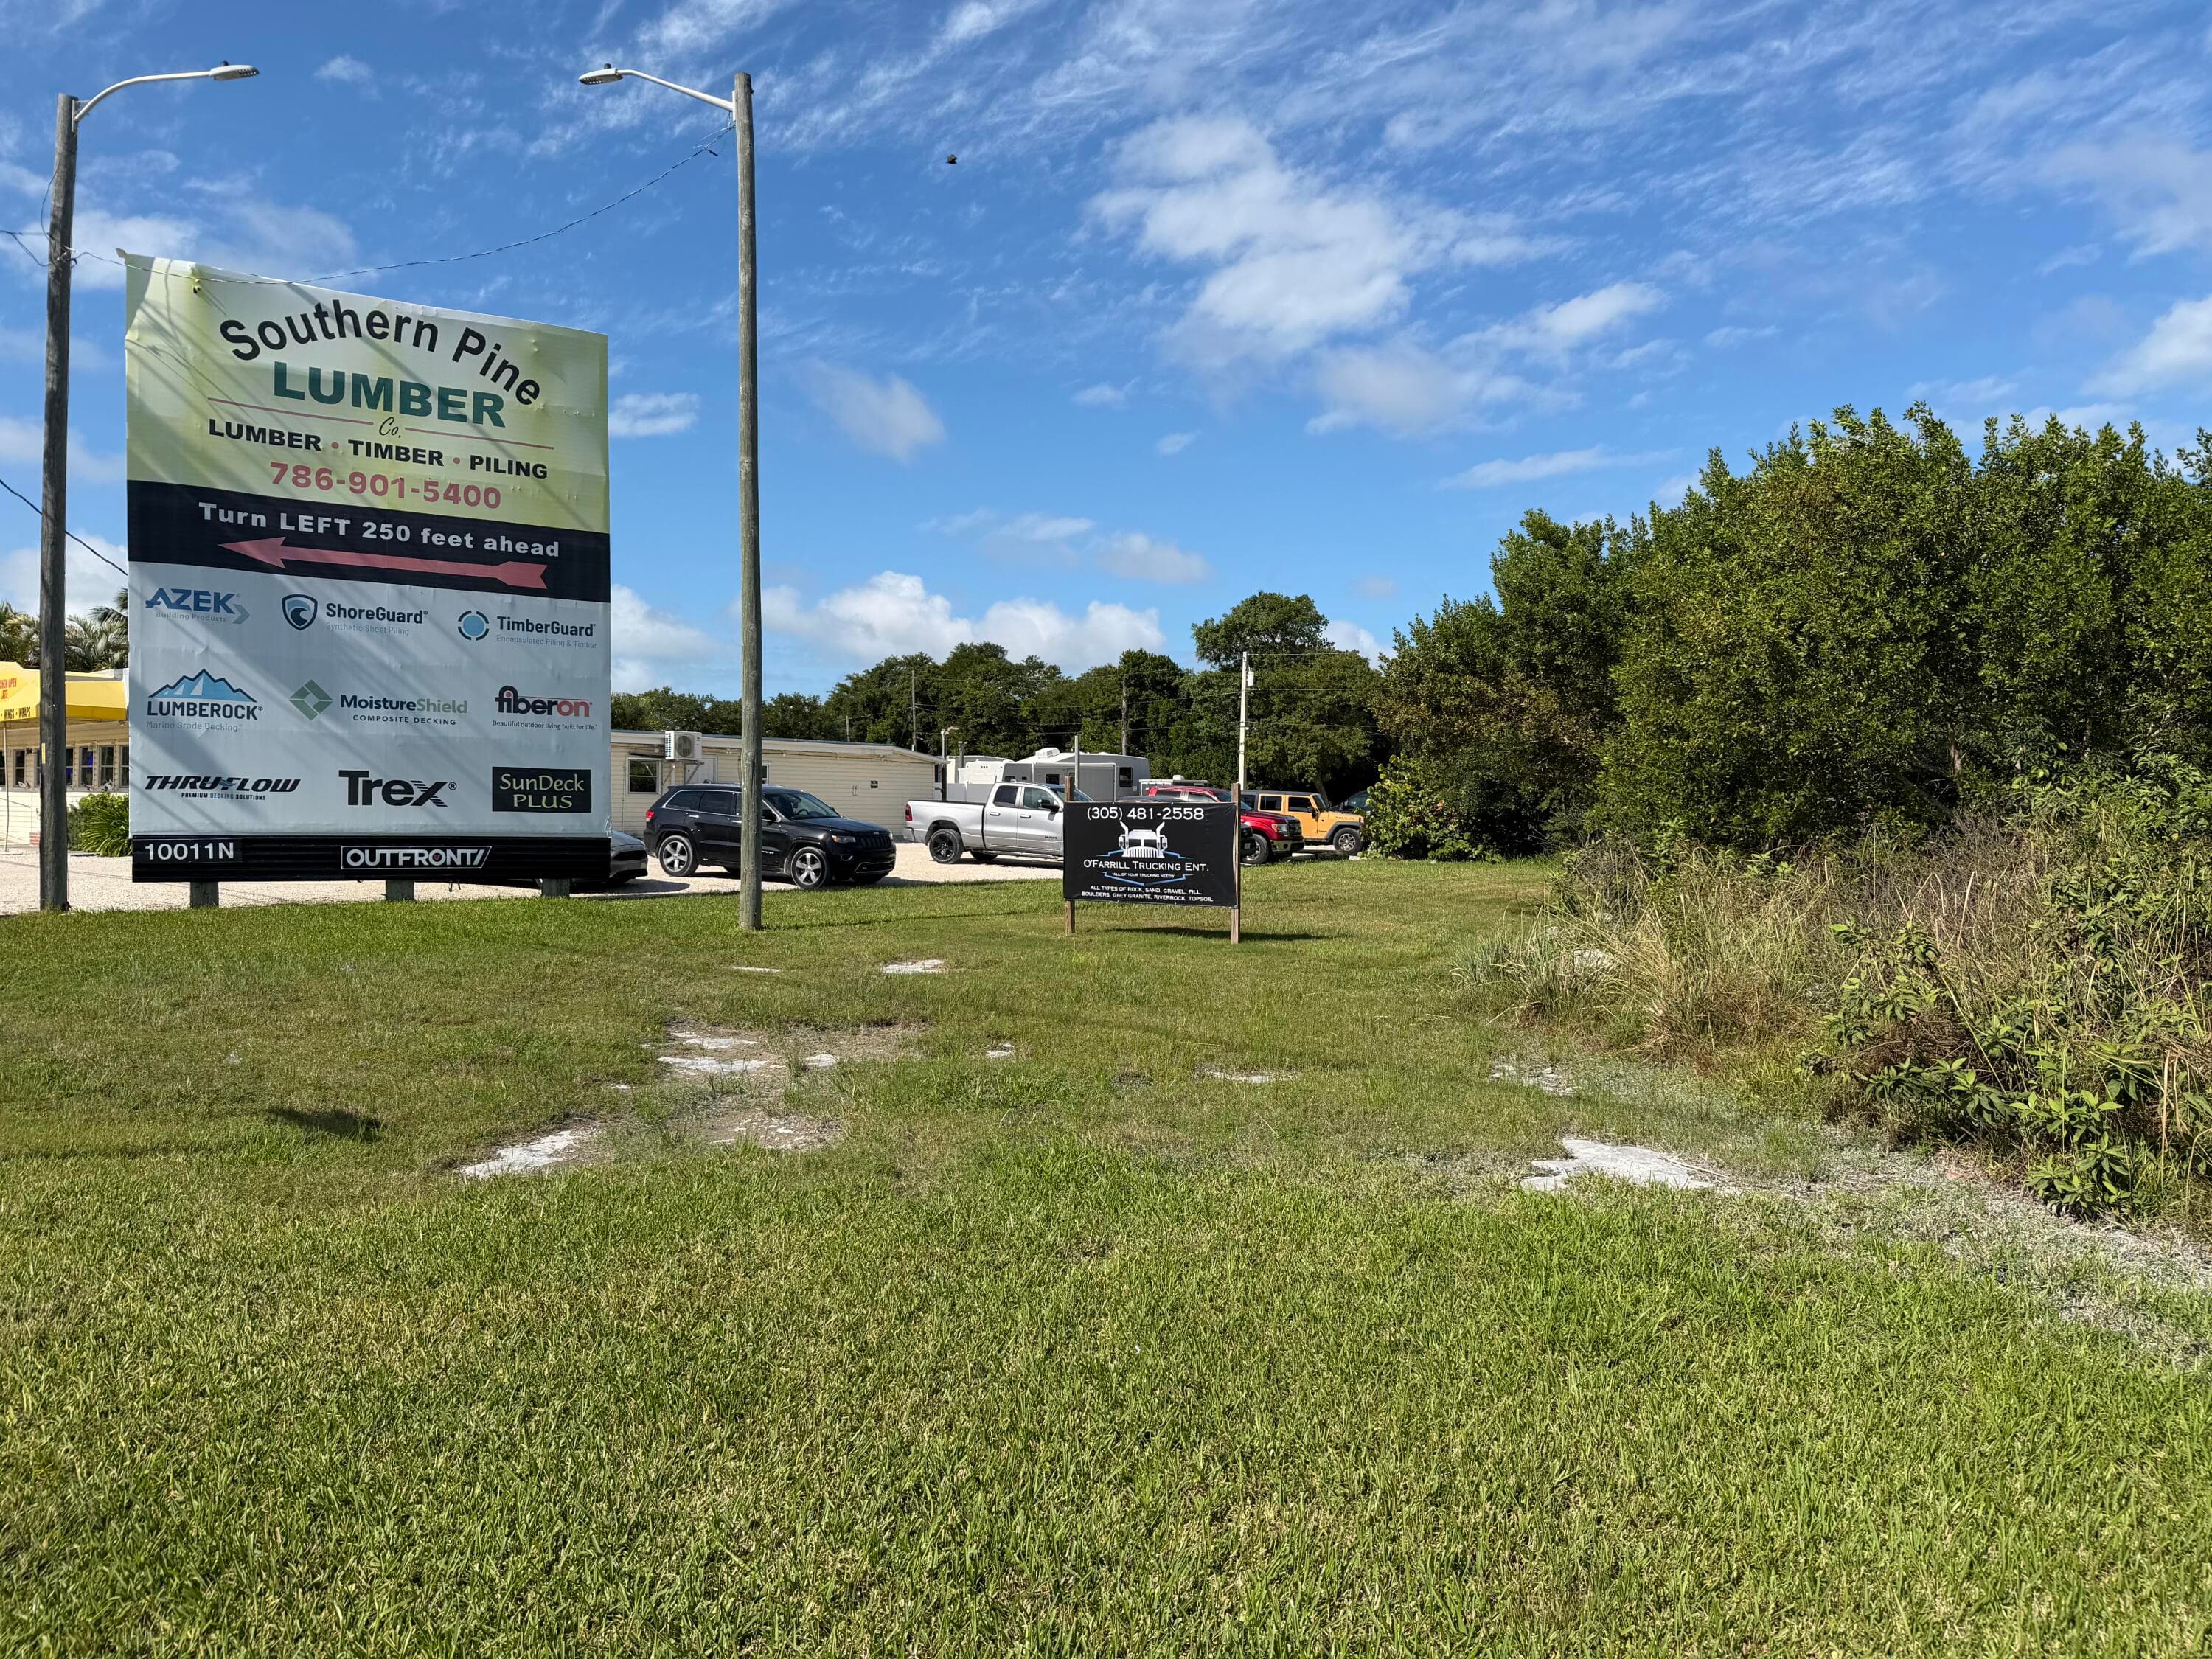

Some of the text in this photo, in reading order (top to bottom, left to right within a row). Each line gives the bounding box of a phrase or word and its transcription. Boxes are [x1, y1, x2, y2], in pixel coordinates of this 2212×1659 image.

[220, 299, 542, 406] Southern Pine
[274, 361, 506, 428] LUMBER
[379, 416, 403, 439] Co.
[209, 418, 548, 480] LUMBER TIMBER PILING
[269, 461, 501, 509] 786-901-5400
[198, 501, 560, 558] Turn LEFT 250 feet ahead
[145, 587, 237, 615] AZEK
[156, 611, 227, 623] Building Products
[325, 622, 411, 638] Synthetic Sheet Piling
[496, 634, 598, 650] Encapsulated Piling & Timber
[340, 694, 468, 714] MoistureShield
[146, 720, 175, 731] Marine
[177, 721, 203, 731] Grade
[352, 714, 456, 726] COMPOSITE DECKING
[521, 721, 544, 729] outdoor
[545, 722, 561, 731] living
[562, 723, 576, 731] built
[499, 773, 585, 793] SunDeck
[512, 794, 574, 809] PLUS
[1086, 807, 1205, 821] (305) 481-2558
[145, 841, 234, 862] 10011N
[1083, 859, 1209, 872] O'FARRILL TRUCKING ENT.
